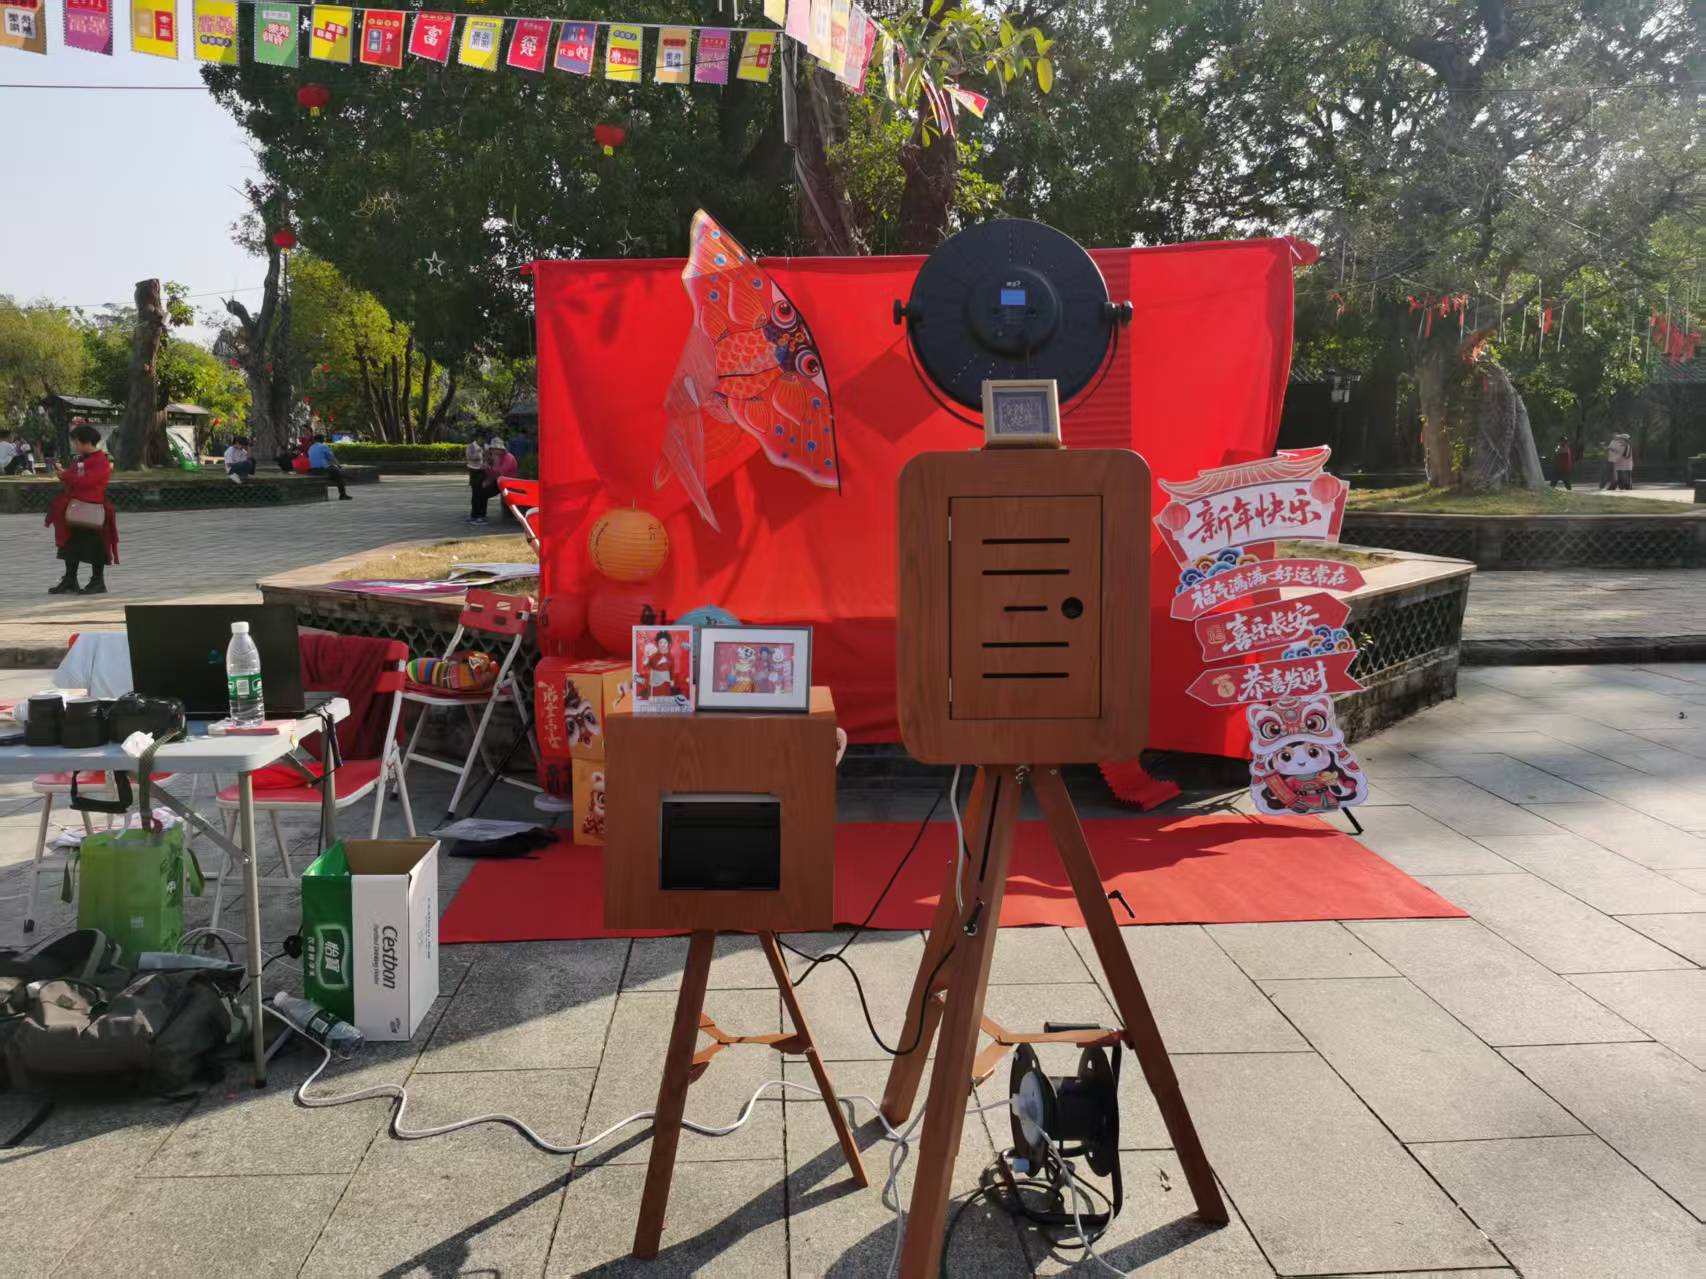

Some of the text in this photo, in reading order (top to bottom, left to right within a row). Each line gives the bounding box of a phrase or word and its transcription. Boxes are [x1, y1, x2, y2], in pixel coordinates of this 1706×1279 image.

[1188, 488, 1322, 545] 新年快乐
[1222, 602, 1320, 653] 喜乐长安
[1237, 660, 1328, 702] 恭喜发财
